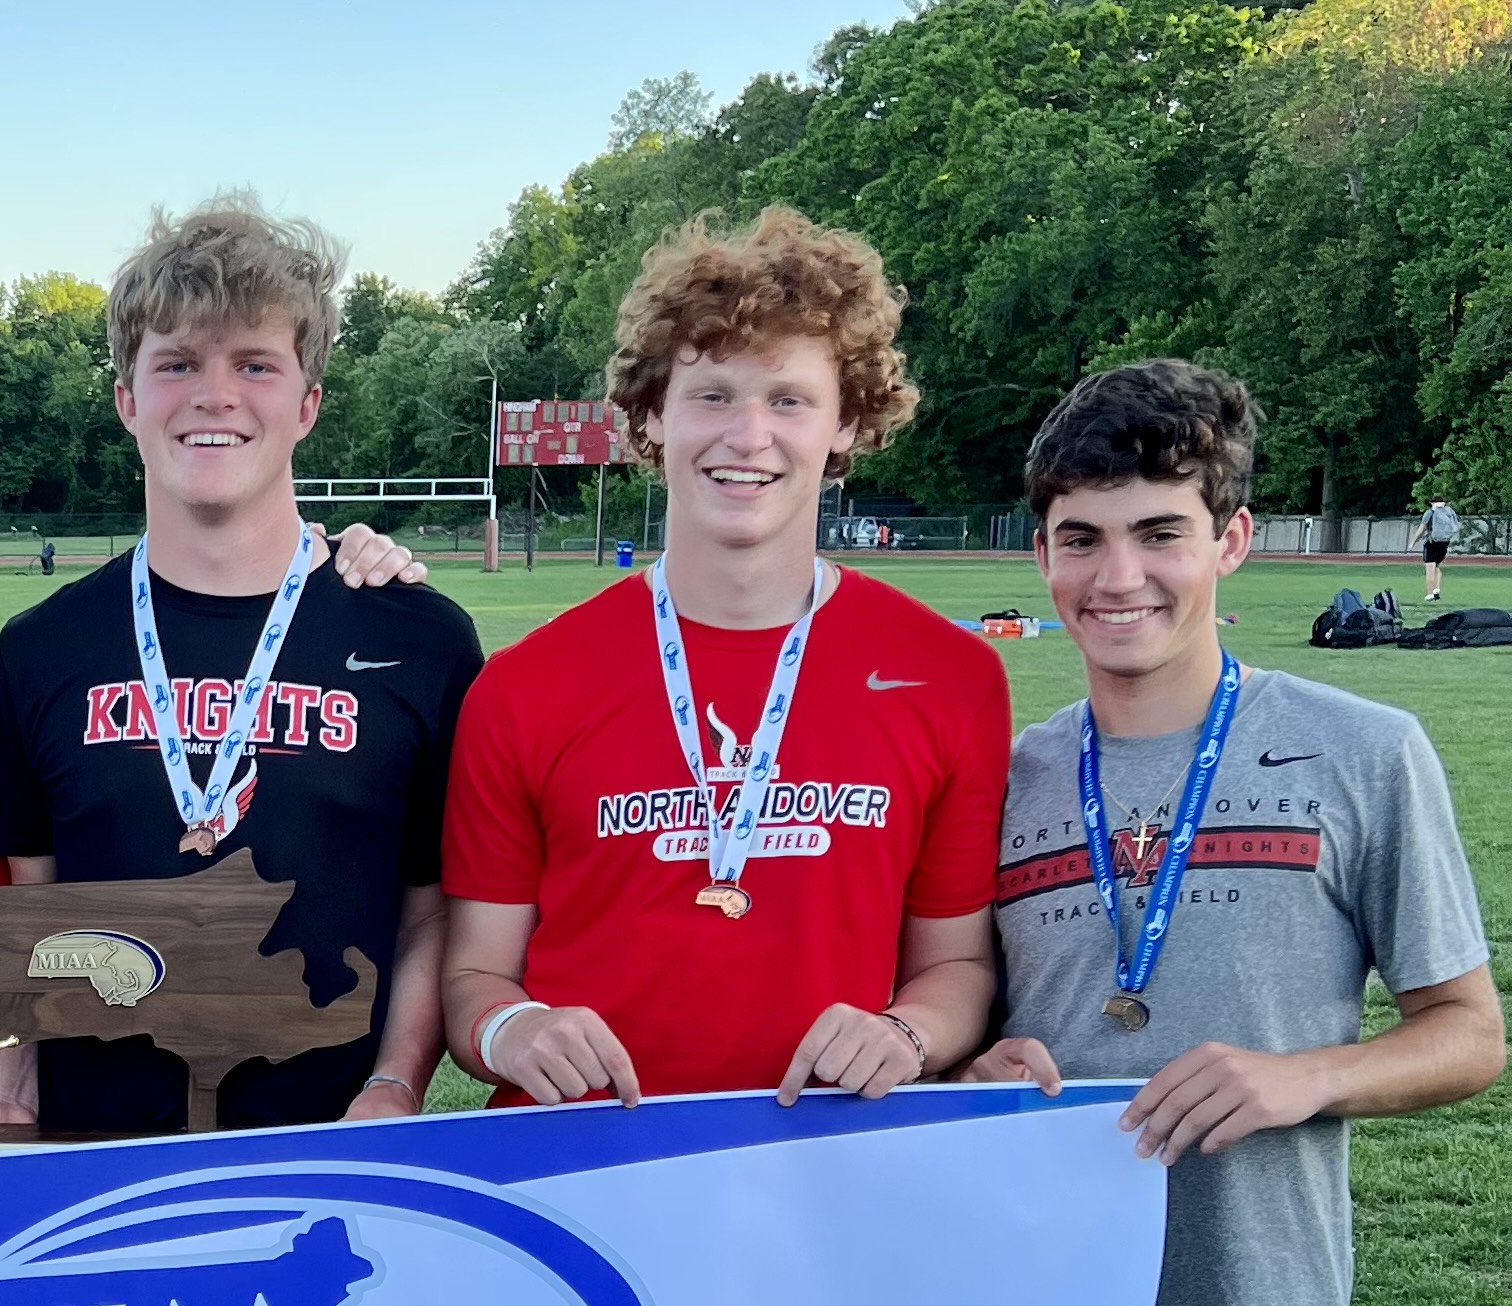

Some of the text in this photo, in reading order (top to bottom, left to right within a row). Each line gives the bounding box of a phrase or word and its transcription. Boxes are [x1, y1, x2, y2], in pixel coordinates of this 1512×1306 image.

[184, 742, 213, 755] RACK
[720, 782, 890, 827] ADOVER
[1184, 769, 1207, 820] CHAMPION
[664, 833, 819, 854] TRAC FIELD
[1012, 798, 1321, 850] ORT ANOVER
[1157, 854, 1181, 906] CHAMPION
[1040, 902, 1100, 926] TRAC
[1179, 889, 1240, 905] IELD
[36, 952, 98, 970] MIAA
